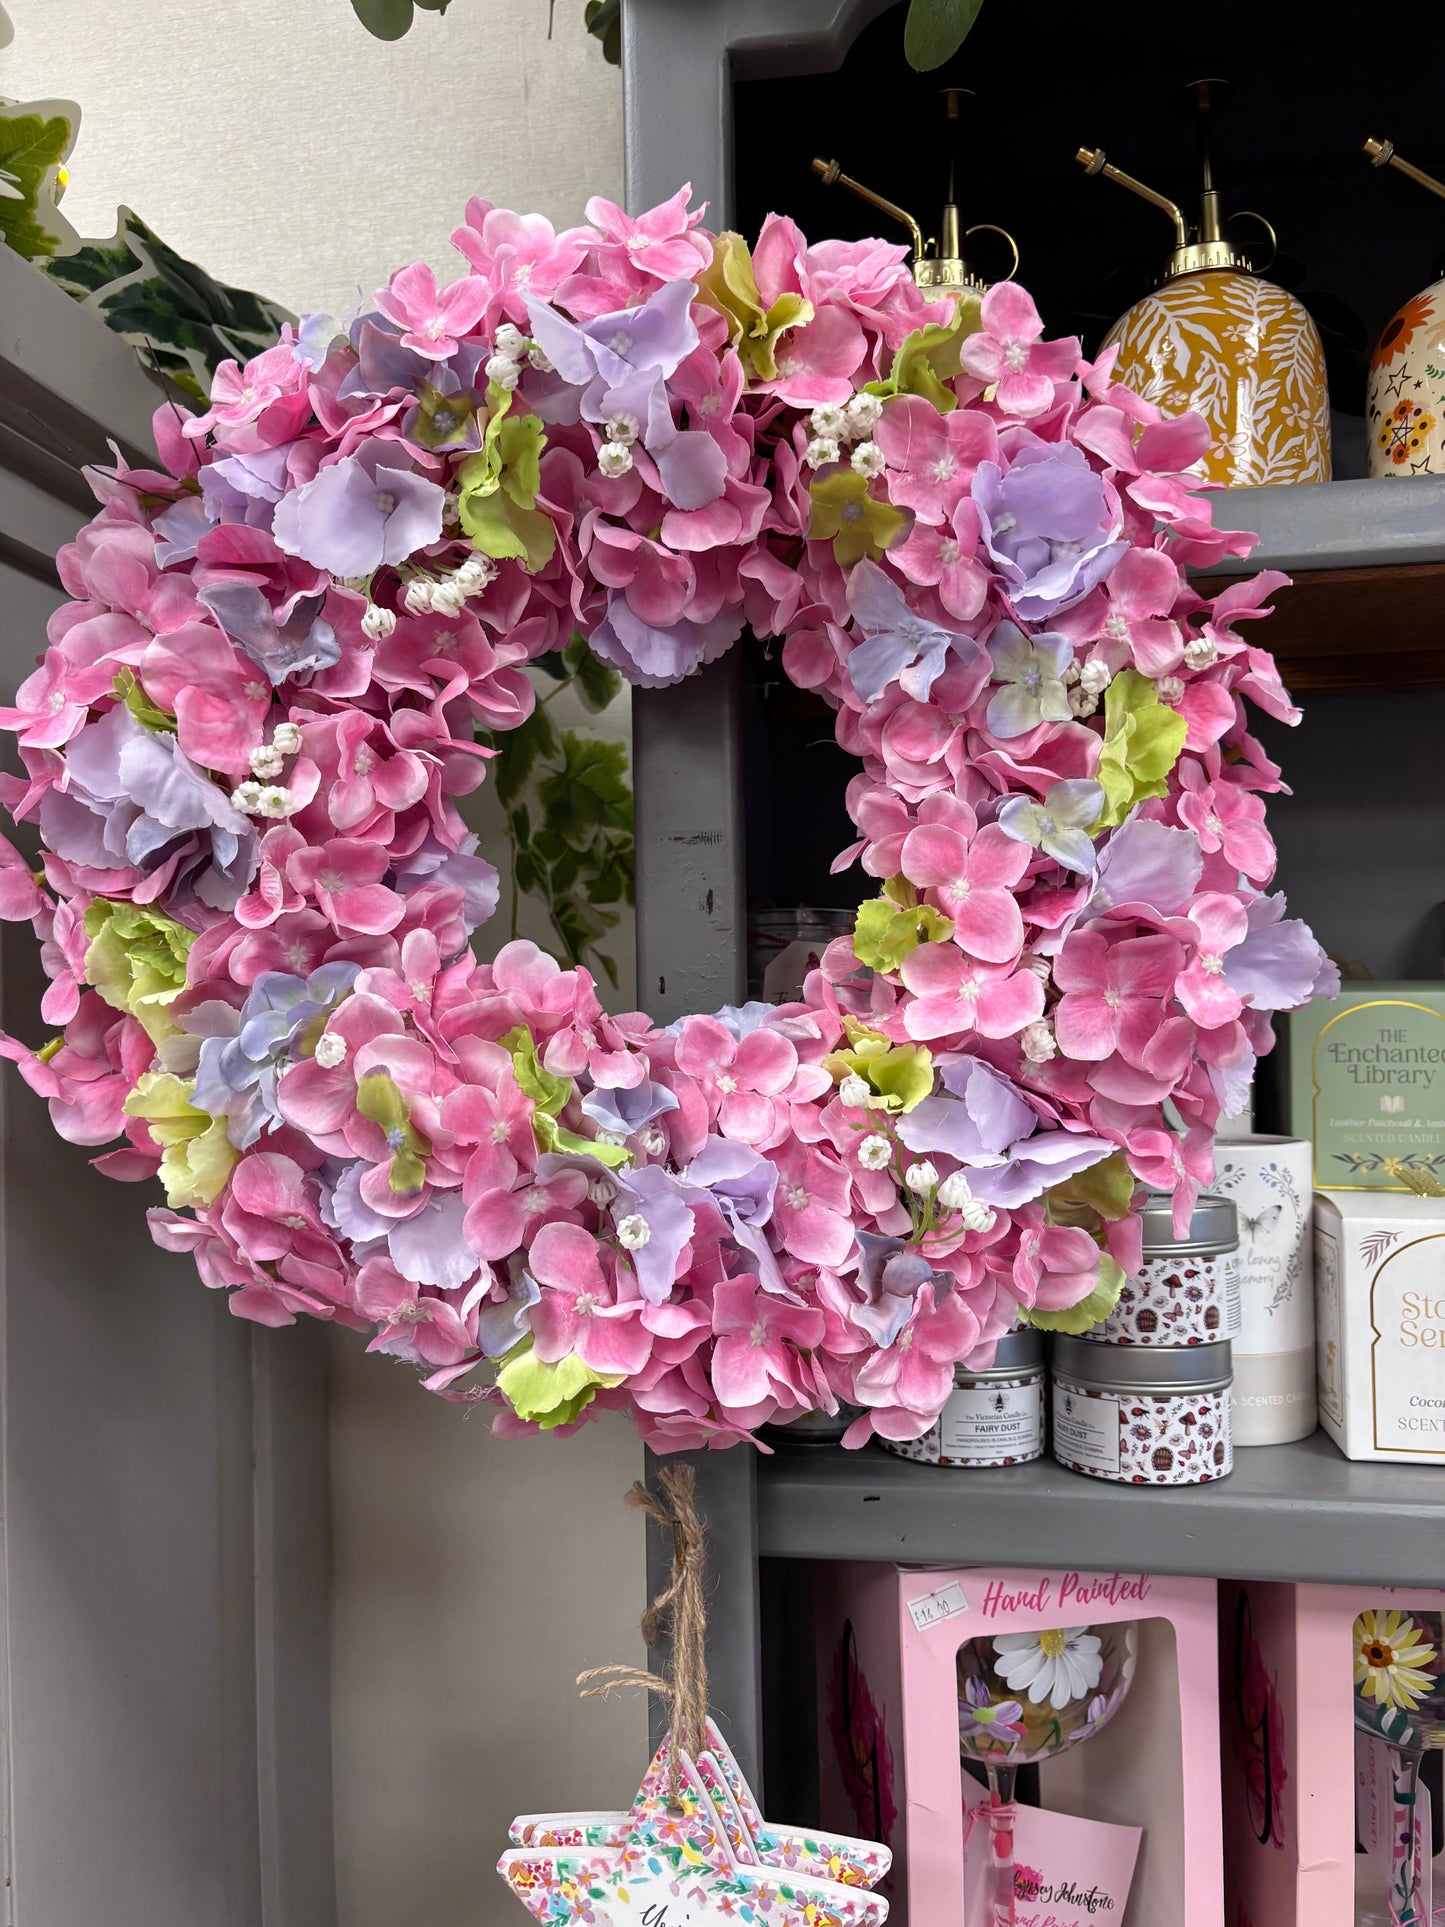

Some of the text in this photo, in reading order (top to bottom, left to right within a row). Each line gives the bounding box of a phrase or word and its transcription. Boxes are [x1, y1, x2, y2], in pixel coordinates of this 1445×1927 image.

[1377, 1029, 1408, 1043] THE
[1327, 1043, 1445, 1063] Enchante
[1346, 1064, 1436, 1089] Library
[1329, 1118, 1365, 1127] Leather
[1367, 1118, 1413, 1127] Patchouli
[1413, 1119, 1422, 1128] &
[1343, 1132, 1440, 1144] SCENTED CANDLE
[1247, 1248, 1281, 1273] loving
[1240, 1274, 1274, 1289] emory
[1240, 1394, 1284, 1407] SCENTED
[975, 1413, 1002, 1421] Victorian
[1003, 1411, 1021, 1419] Candle
[975, 1422, 1021, 1433] FAIRY DUST
[1069, 1428, 1088, 1439] DUST
[982, 1572, 1152, 1618] Hand Painted
[1054, 1882, 1115, 1914] Johnstone
